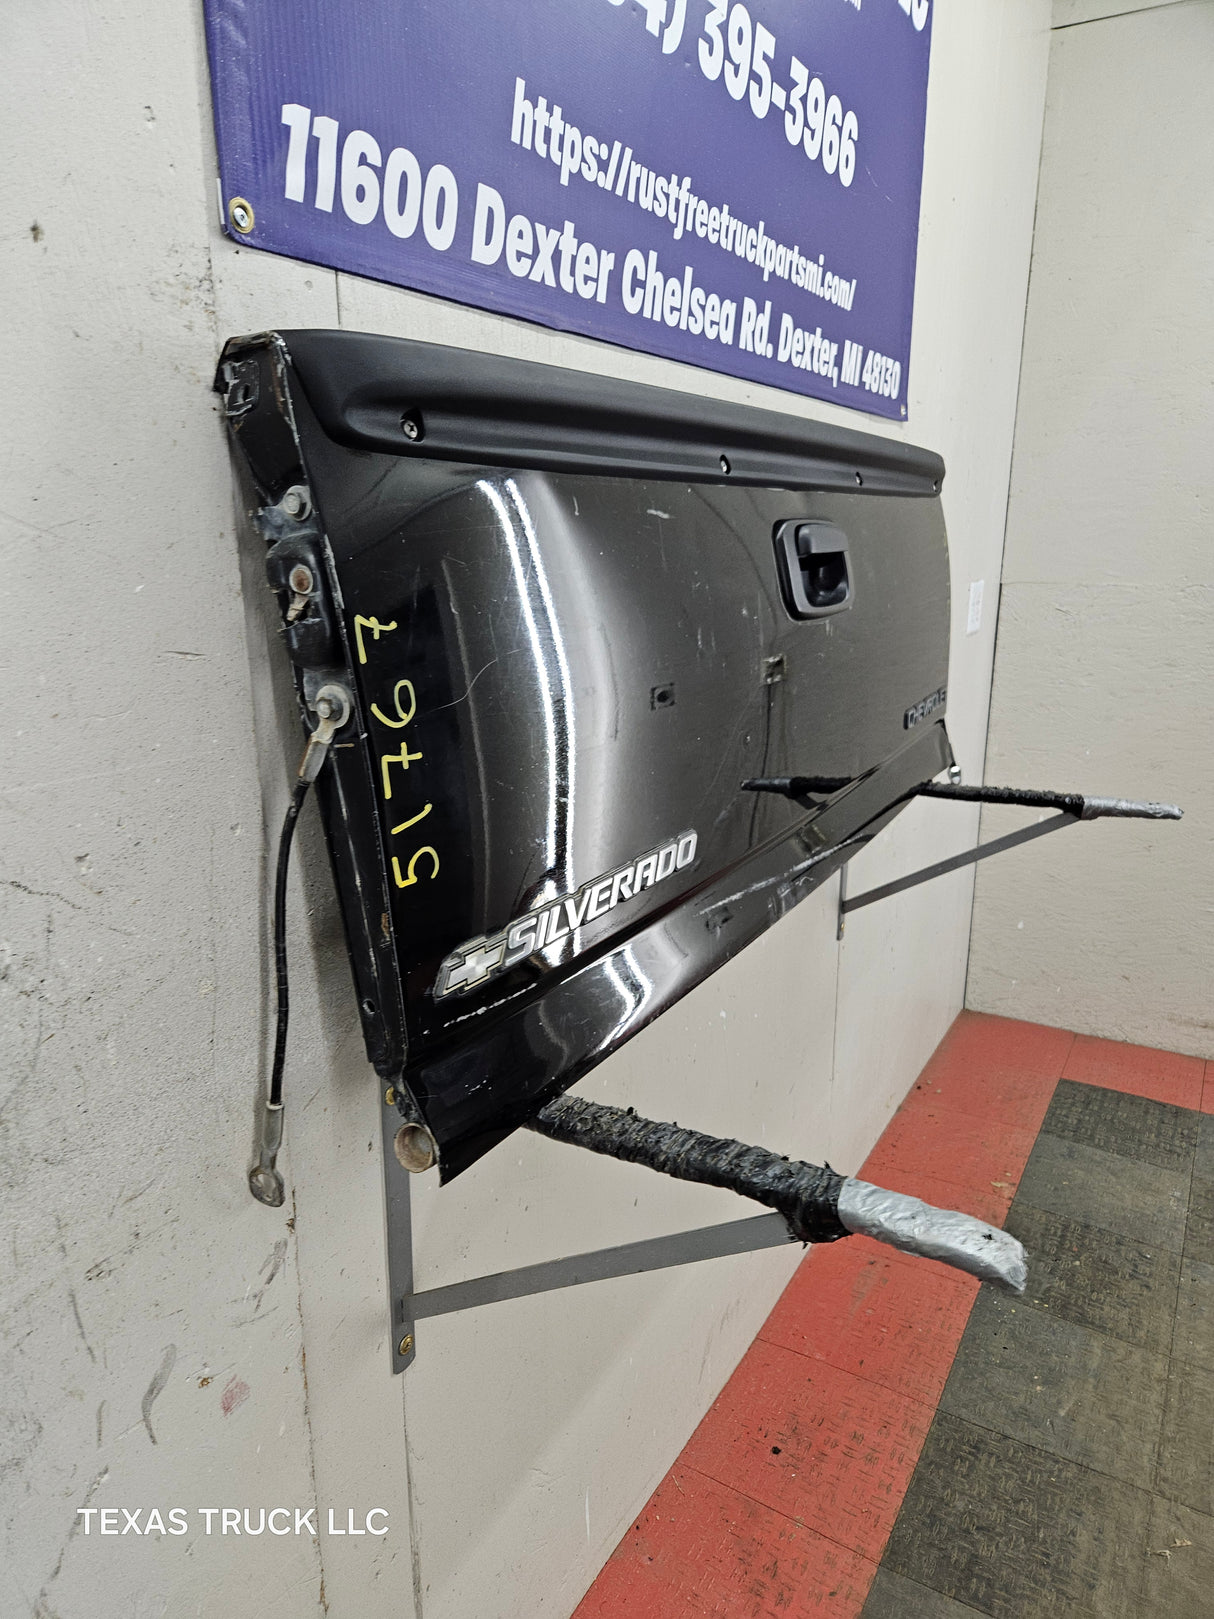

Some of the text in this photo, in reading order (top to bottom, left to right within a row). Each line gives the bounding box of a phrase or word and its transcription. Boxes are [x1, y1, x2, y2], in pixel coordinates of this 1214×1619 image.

[511, 77, 857, 311] https://rustfreetruckpartsmi.com/
[698, 0, 859, 188] 395-3966
[281, 103, 902, 400] 11600 Dexter Chelsea Rd. Dexter, MI 48130
[503, 829, 698, 968] SILVERADO
